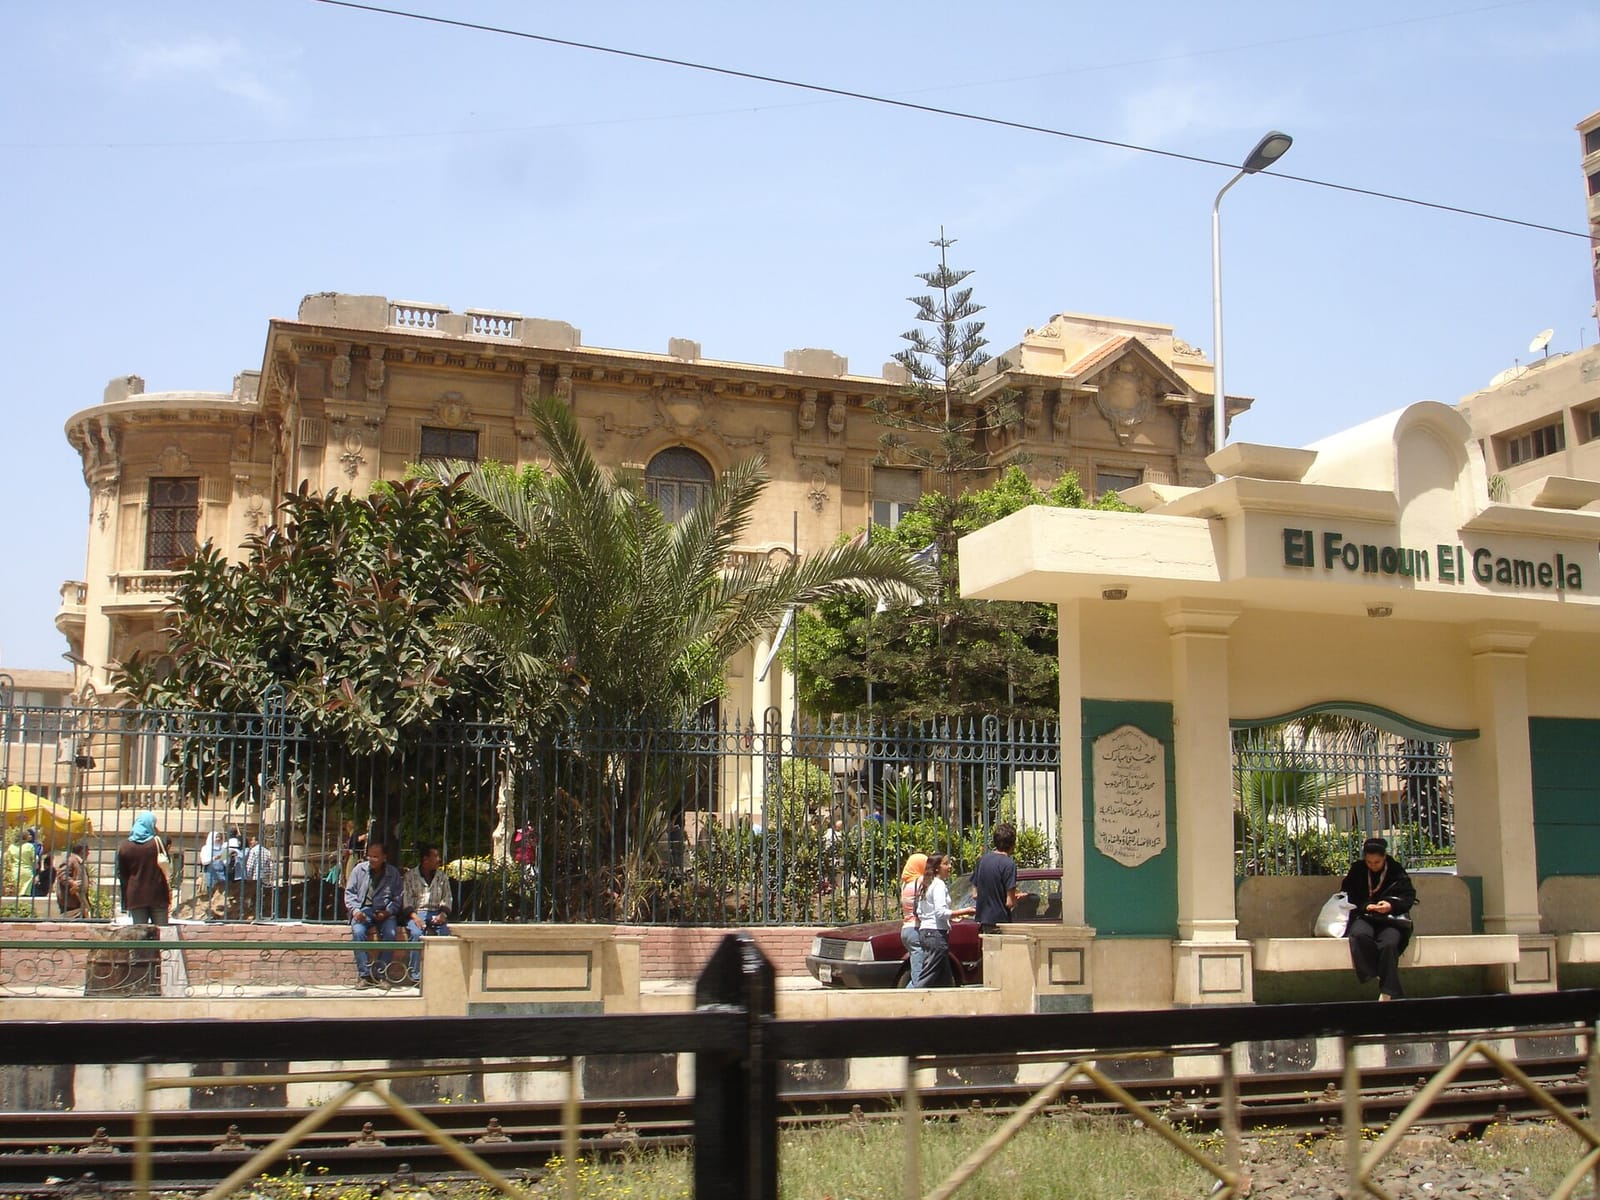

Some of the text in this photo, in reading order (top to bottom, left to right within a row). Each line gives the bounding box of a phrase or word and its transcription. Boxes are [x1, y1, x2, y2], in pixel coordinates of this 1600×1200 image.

[1283, 528, 1583, 590] El Fonoun El Gamela
